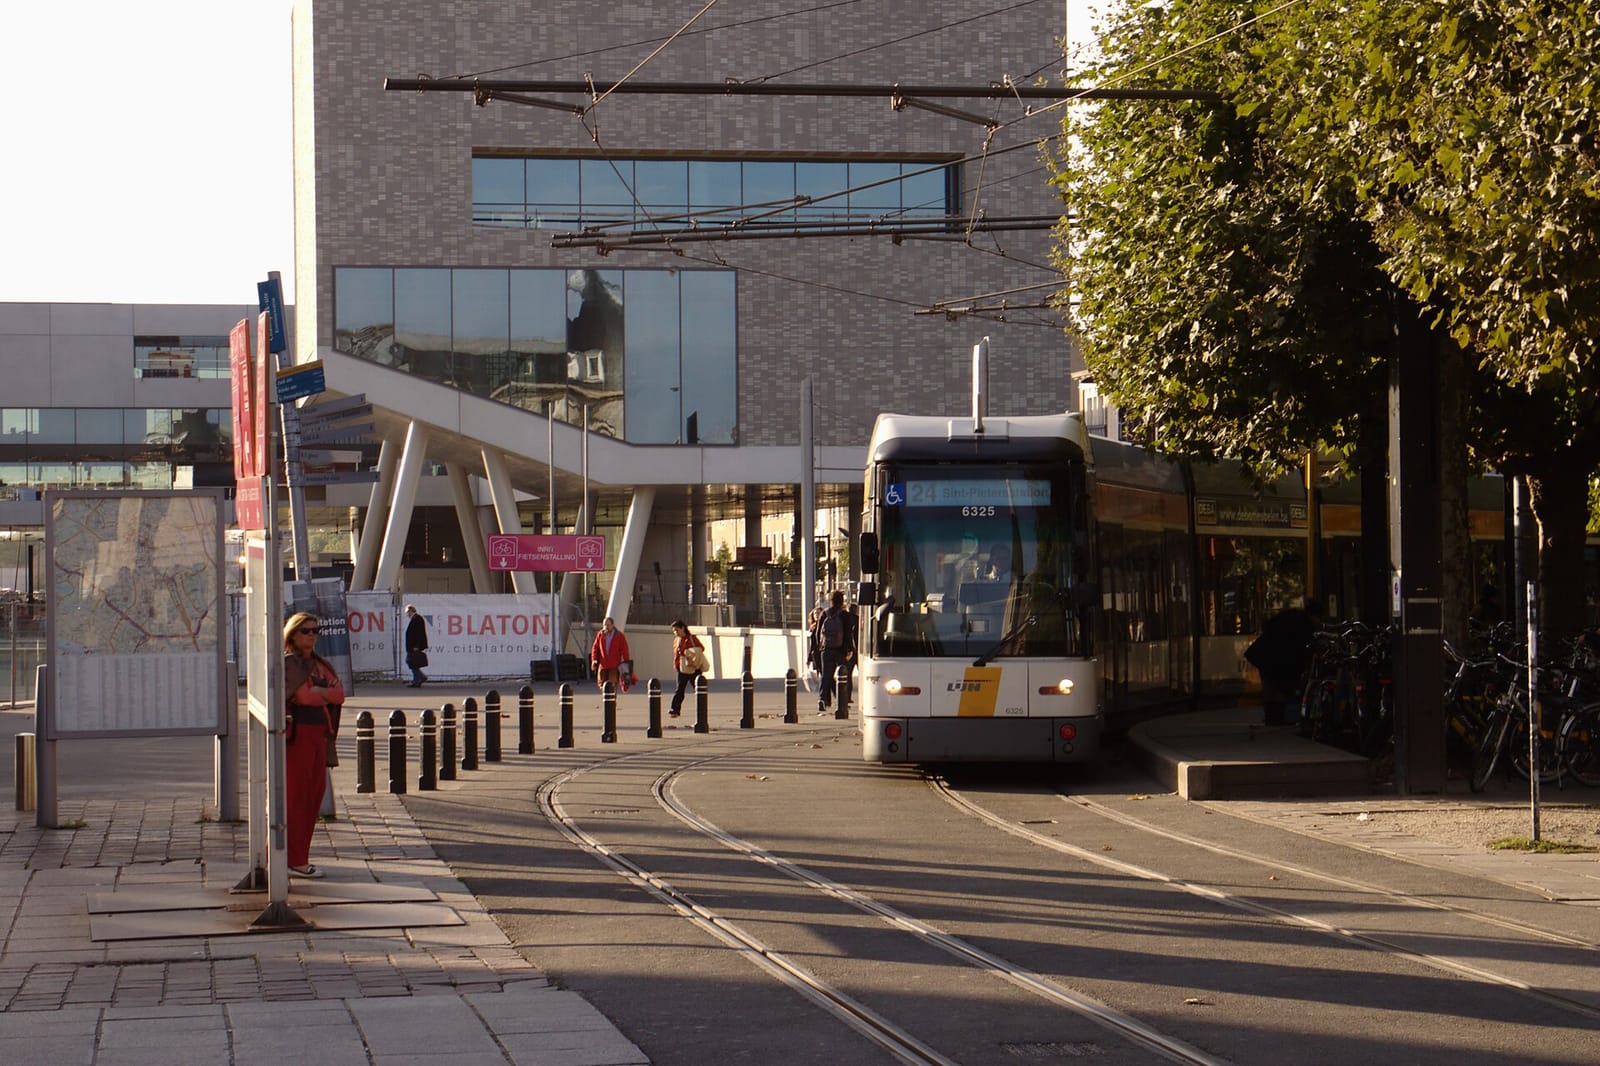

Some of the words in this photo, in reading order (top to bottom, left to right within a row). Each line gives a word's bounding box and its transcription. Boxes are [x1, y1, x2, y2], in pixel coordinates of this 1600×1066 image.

[911, 482, 937, 503] 24
[961, 506, 996, 517] 6325
[518, 553, 576, 561] FIETSENSTALLING
[447, 614, 550, 636] BLATON
[1005, 707, 1024, 715] 6325
